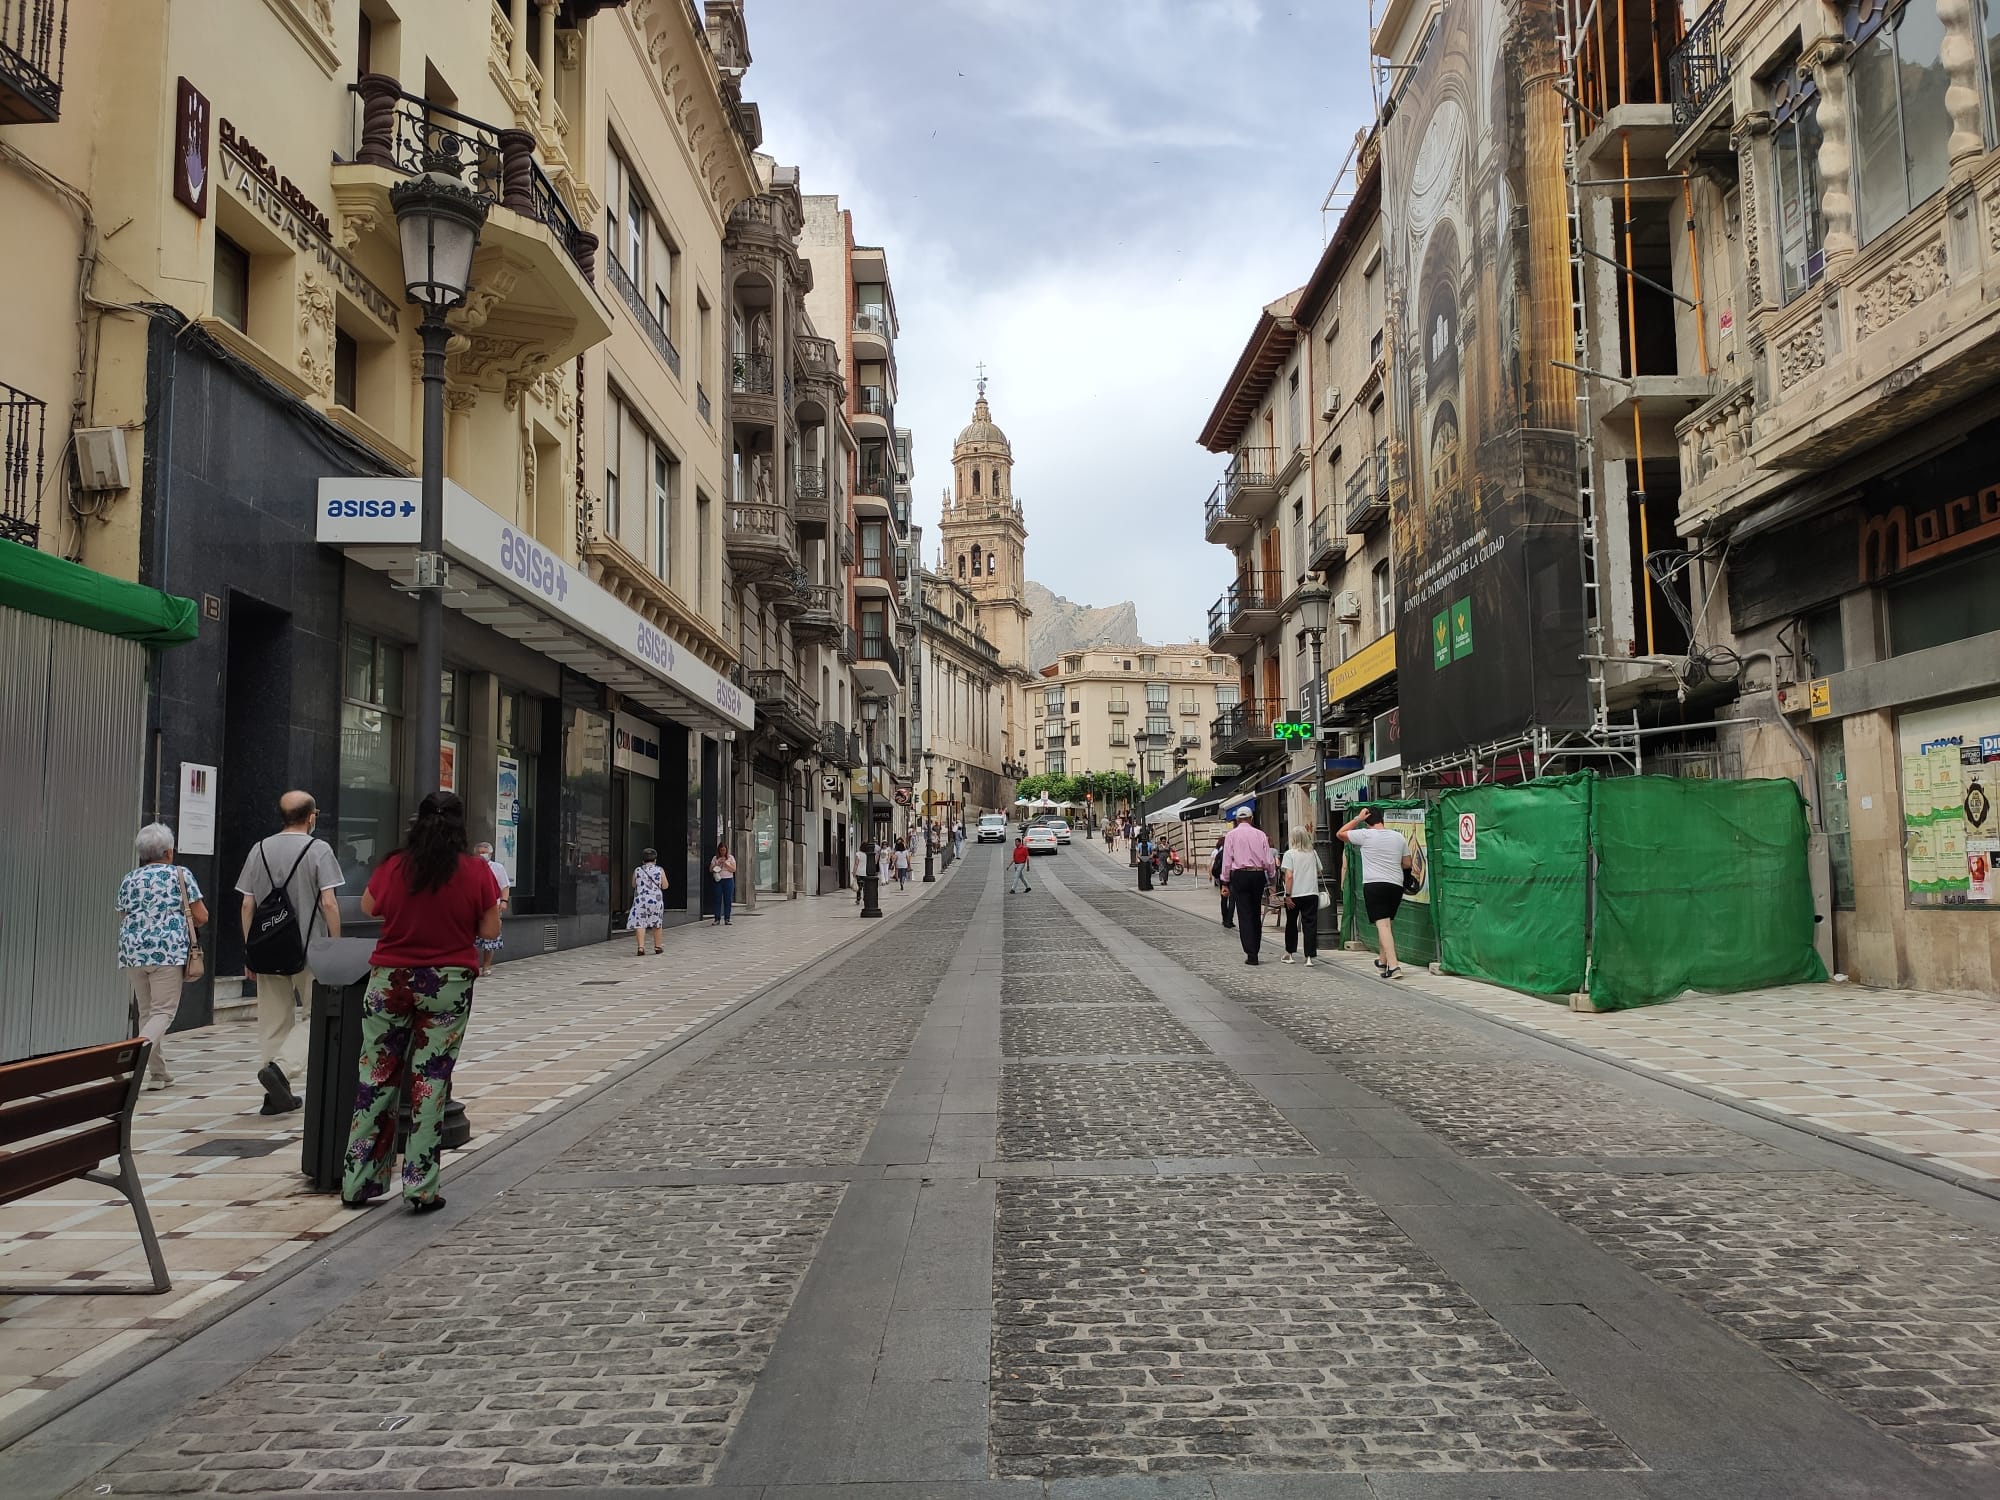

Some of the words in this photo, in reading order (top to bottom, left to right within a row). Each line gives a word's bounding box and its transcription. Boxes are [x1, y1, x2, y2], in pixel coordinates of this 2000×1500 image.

[280, 175, 334, 242] DENTAL
[327, 499, 396, 518] asisa
[500, 527, 555, 597] asisa
[1404, 593, 1420, 614] JUNTO
[1420, 588, 1428, 604] AL
[1427, 565, 1460, 599] PATRIMONIO
[1460, 558, 1470, 576] DE
[1469, 552, 1479, 570] LA
[1479, 535, 1505, 563] CIUDAD
[636, 621, 669, 669] asisa
[716, 678, 738, 712] asisa
